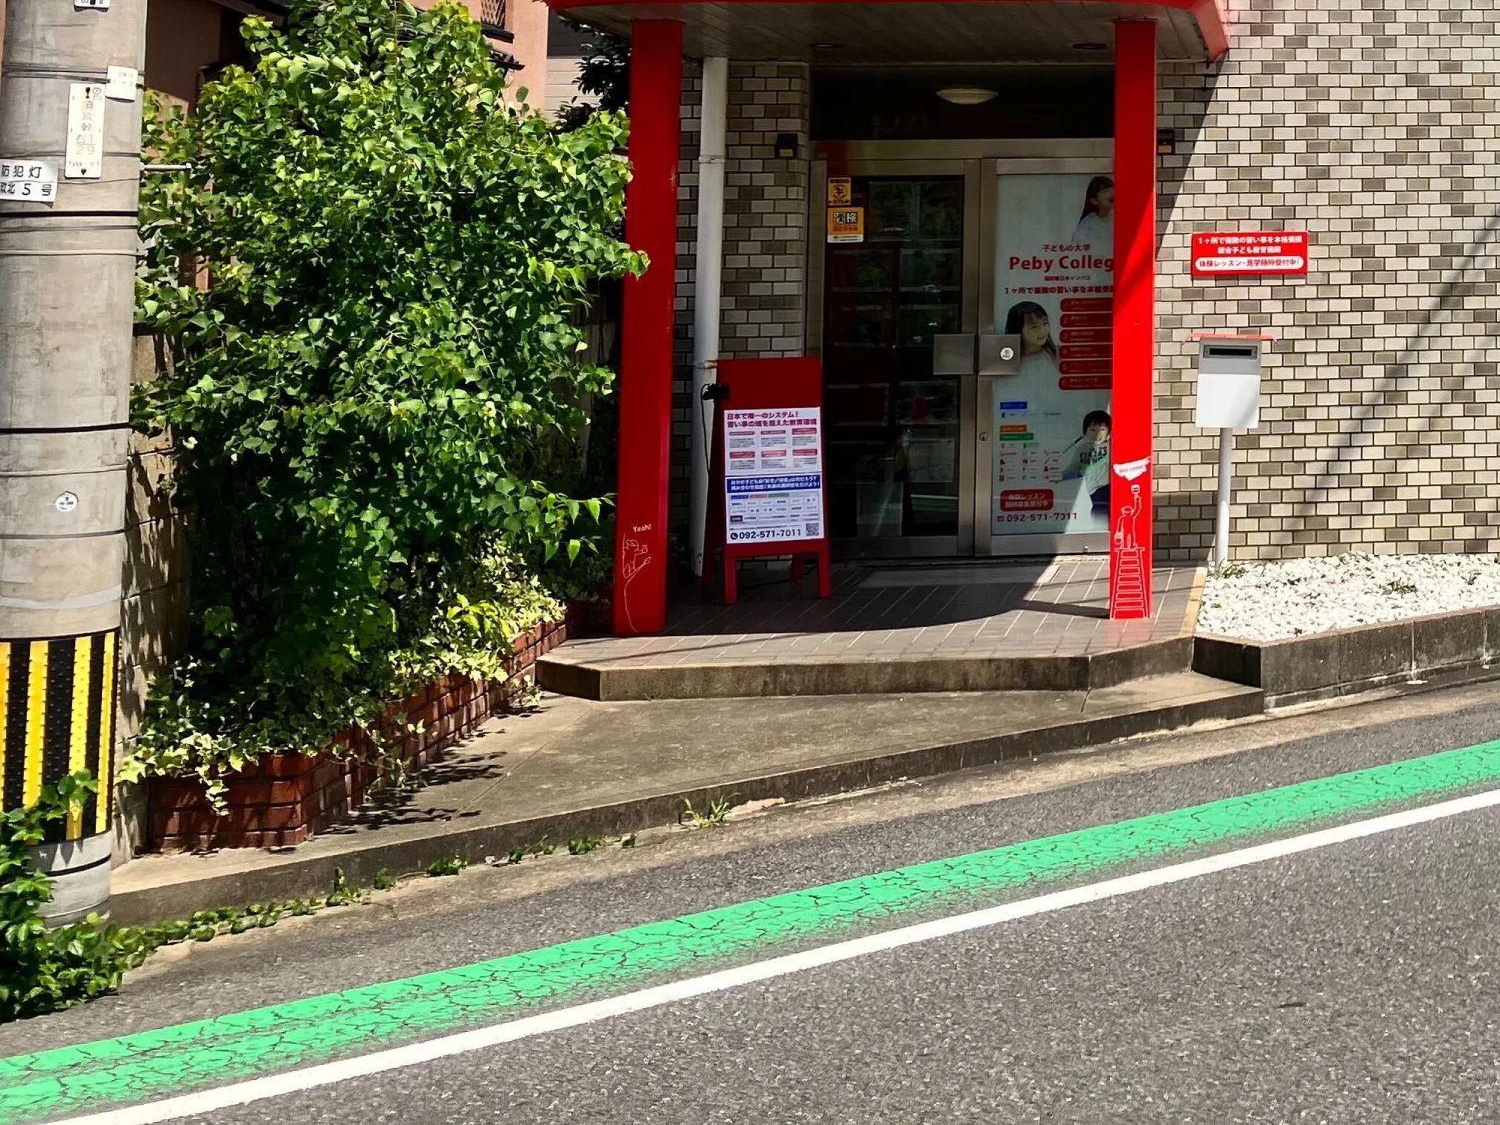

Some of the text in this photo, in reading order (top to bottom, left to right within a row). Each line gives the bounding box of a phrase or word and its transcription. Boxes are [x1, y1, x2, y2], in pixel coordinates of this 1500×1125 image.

[2, 165, 42, 178] 防犯灯
[1042, 244, 1091, 252] 子どもの大学
[1009, 256, 1053, 273] Peby
[739, 529, 801, 540] 092-571-7011
